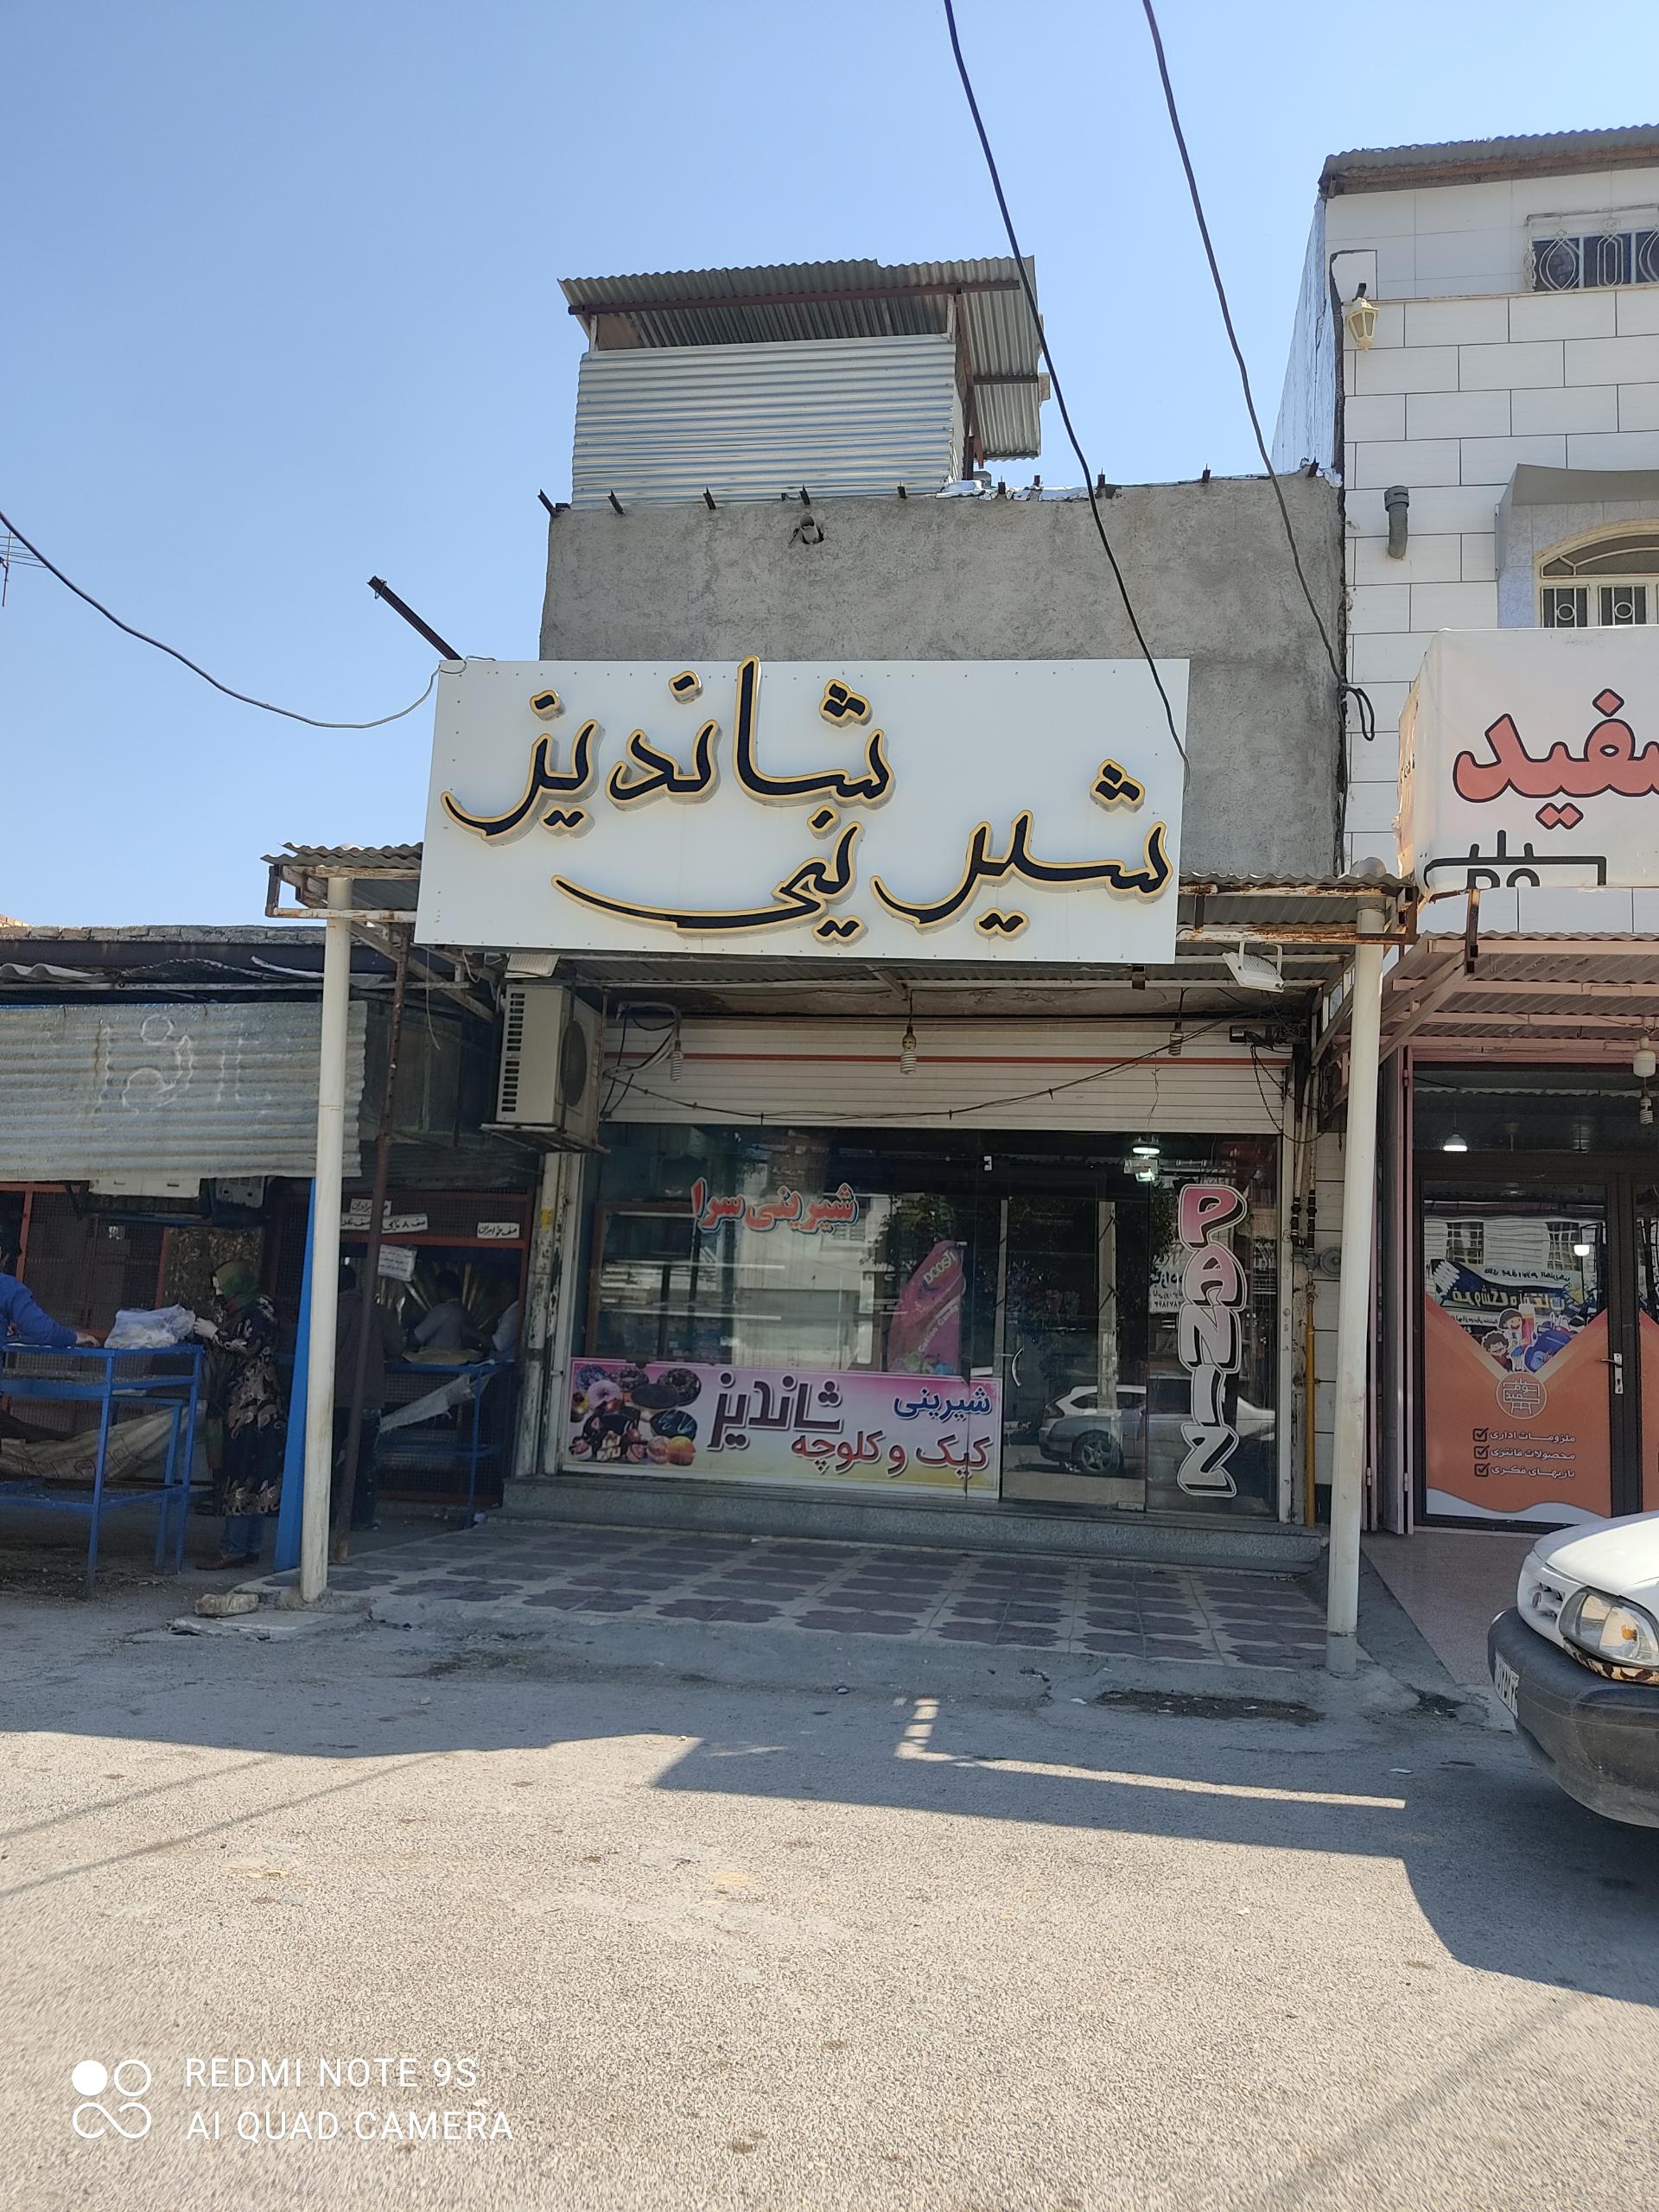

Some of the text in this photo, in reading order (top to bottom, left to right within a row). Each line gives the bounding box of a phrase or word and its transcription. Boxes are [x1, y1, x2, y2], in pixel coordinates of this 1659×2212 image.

[440, 655, 895, 847] شاندیز
[551, 759, 1175, 944] شیرینی
[691, 1176, 859, 1236] شیرینی سرا
[1177, 1184, 1248, 1497] PANIZ
[706, 1370, 843, 1452] شاندیز
[893, 1385, 993, 1423] شیرینی
[791, 1430, 992, 1478] کیک و کلوچه
